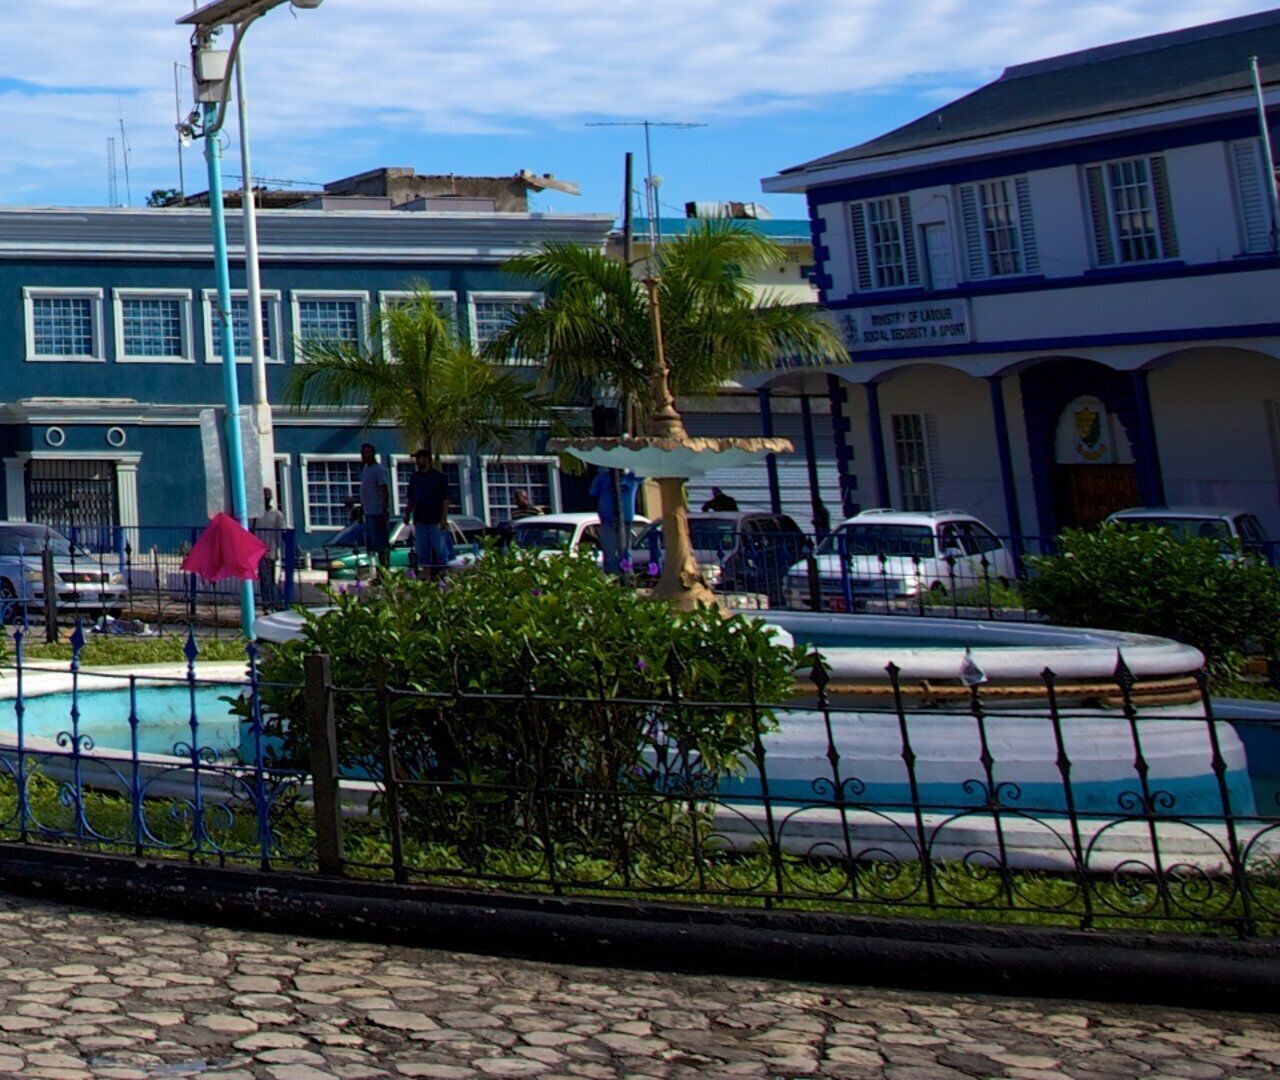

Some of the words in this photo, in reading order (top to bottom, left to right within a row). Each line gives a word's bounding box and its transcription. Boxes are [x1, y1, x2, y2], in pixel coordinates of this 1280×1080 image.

[871, 312, 904, 326] MINISTRY
[908, 310, 918, 322] OF
[920, 308, 952, 322] LABOUR
[863, 330, 889, 343] SOCIAL
[890, 326, 927, 341] SECURITY
